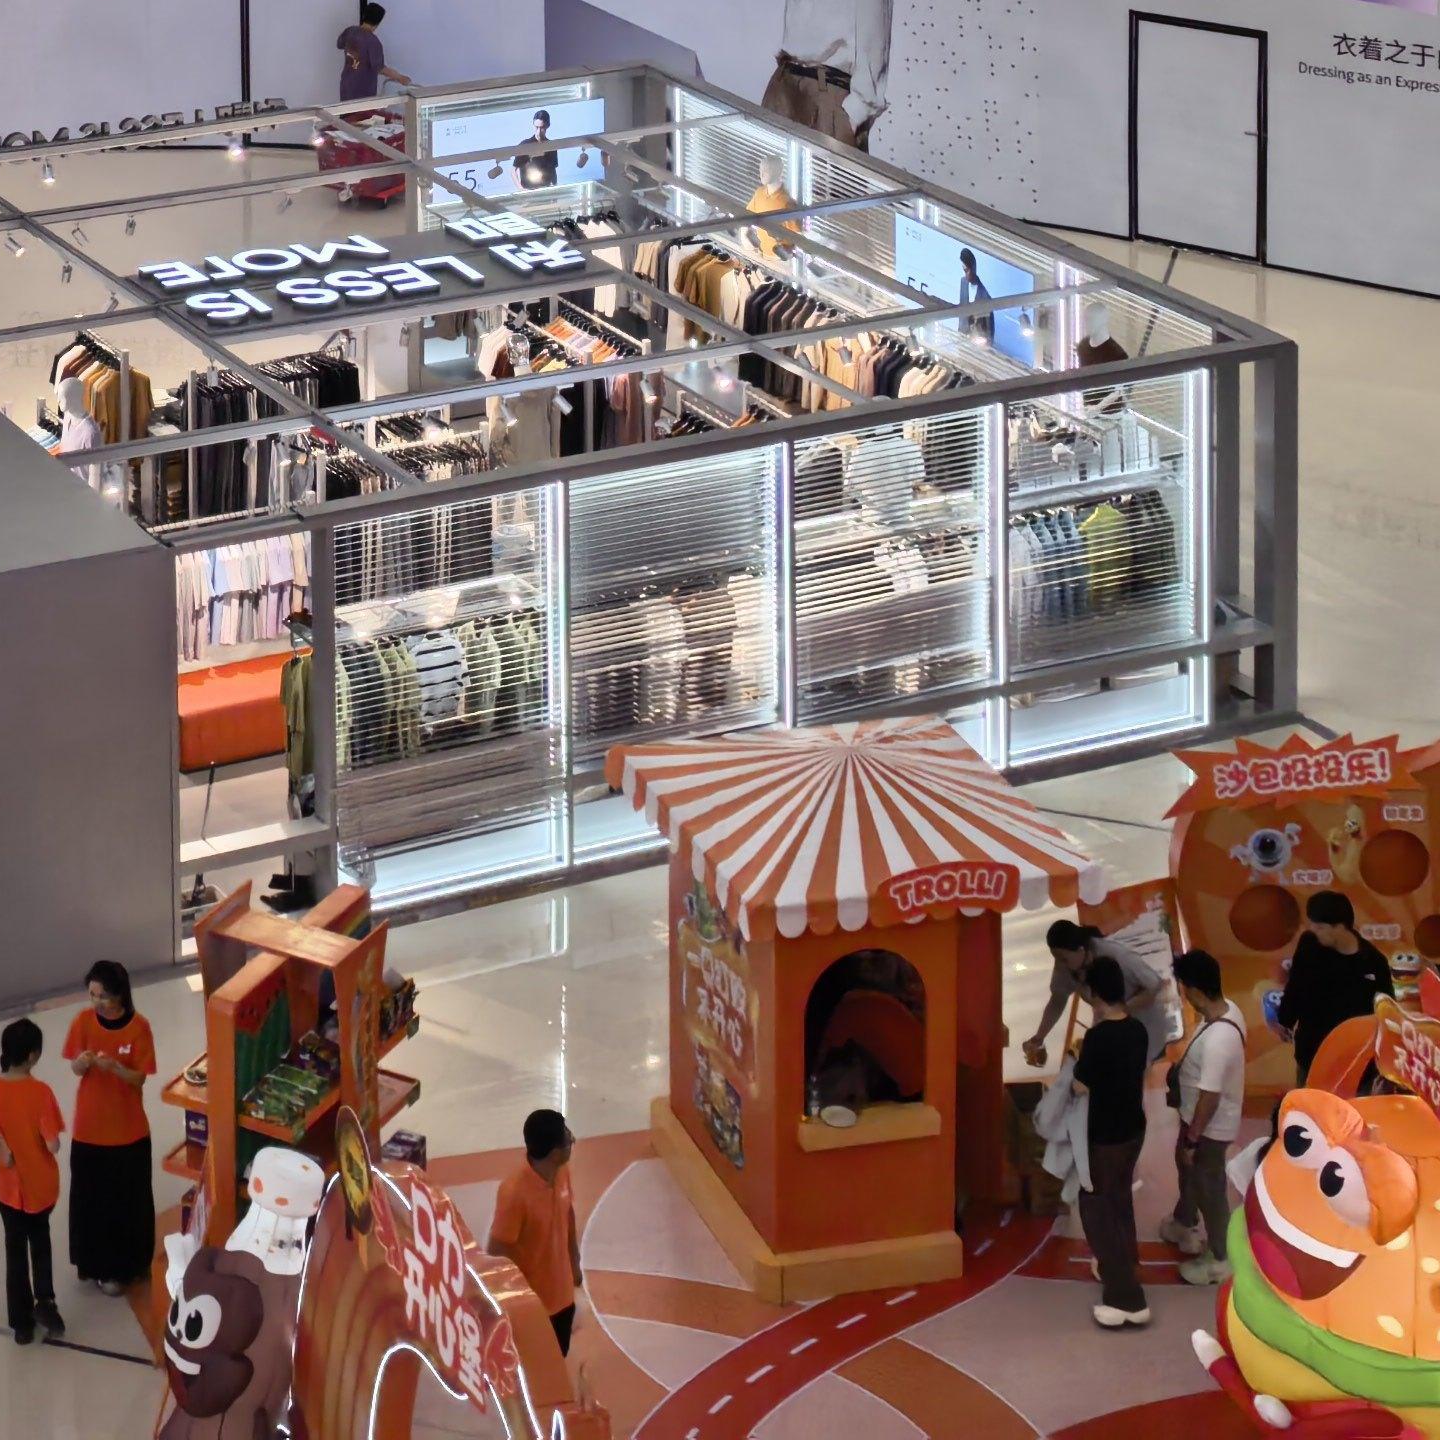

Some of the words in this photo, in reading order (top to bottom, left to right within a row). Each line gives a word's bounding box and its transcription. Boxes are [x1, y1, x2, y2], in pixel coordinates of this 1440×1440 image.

[1298, 60, 1355, 85] Dressing
[1356, 71, 1373, 84] as
[1374, 74, 1392, 87] an
[275, 254, 485, 305] LESS
[185, 287, 273, 320] IS
[889, 868, 1007, 913] TROLLI
